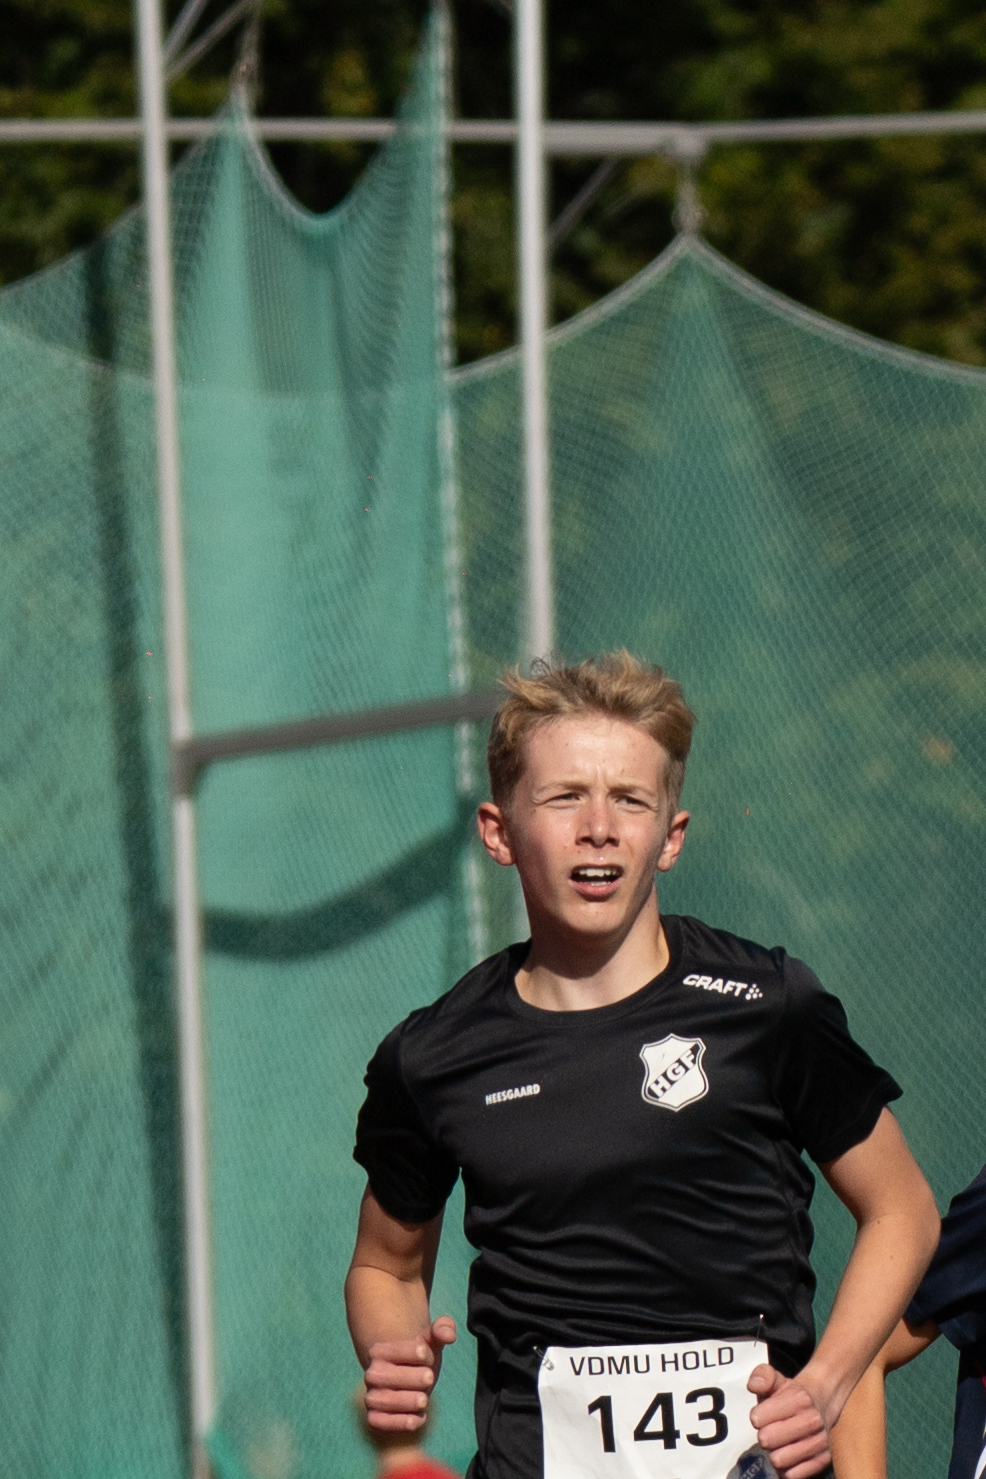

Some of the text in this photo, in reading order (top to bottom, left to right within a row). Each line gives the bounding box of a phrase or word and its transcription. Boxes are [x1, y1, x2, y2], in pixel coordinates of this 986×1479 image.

[682, 974, 748, 998] CRAFT
[649, 1049, 696, 1099] HGF
[485, 1083, 541, 1106] HEESGAARD
[569, 1346, 735, 1376] VDMU HOLD
[587, 1386, 729, 1453] 143
